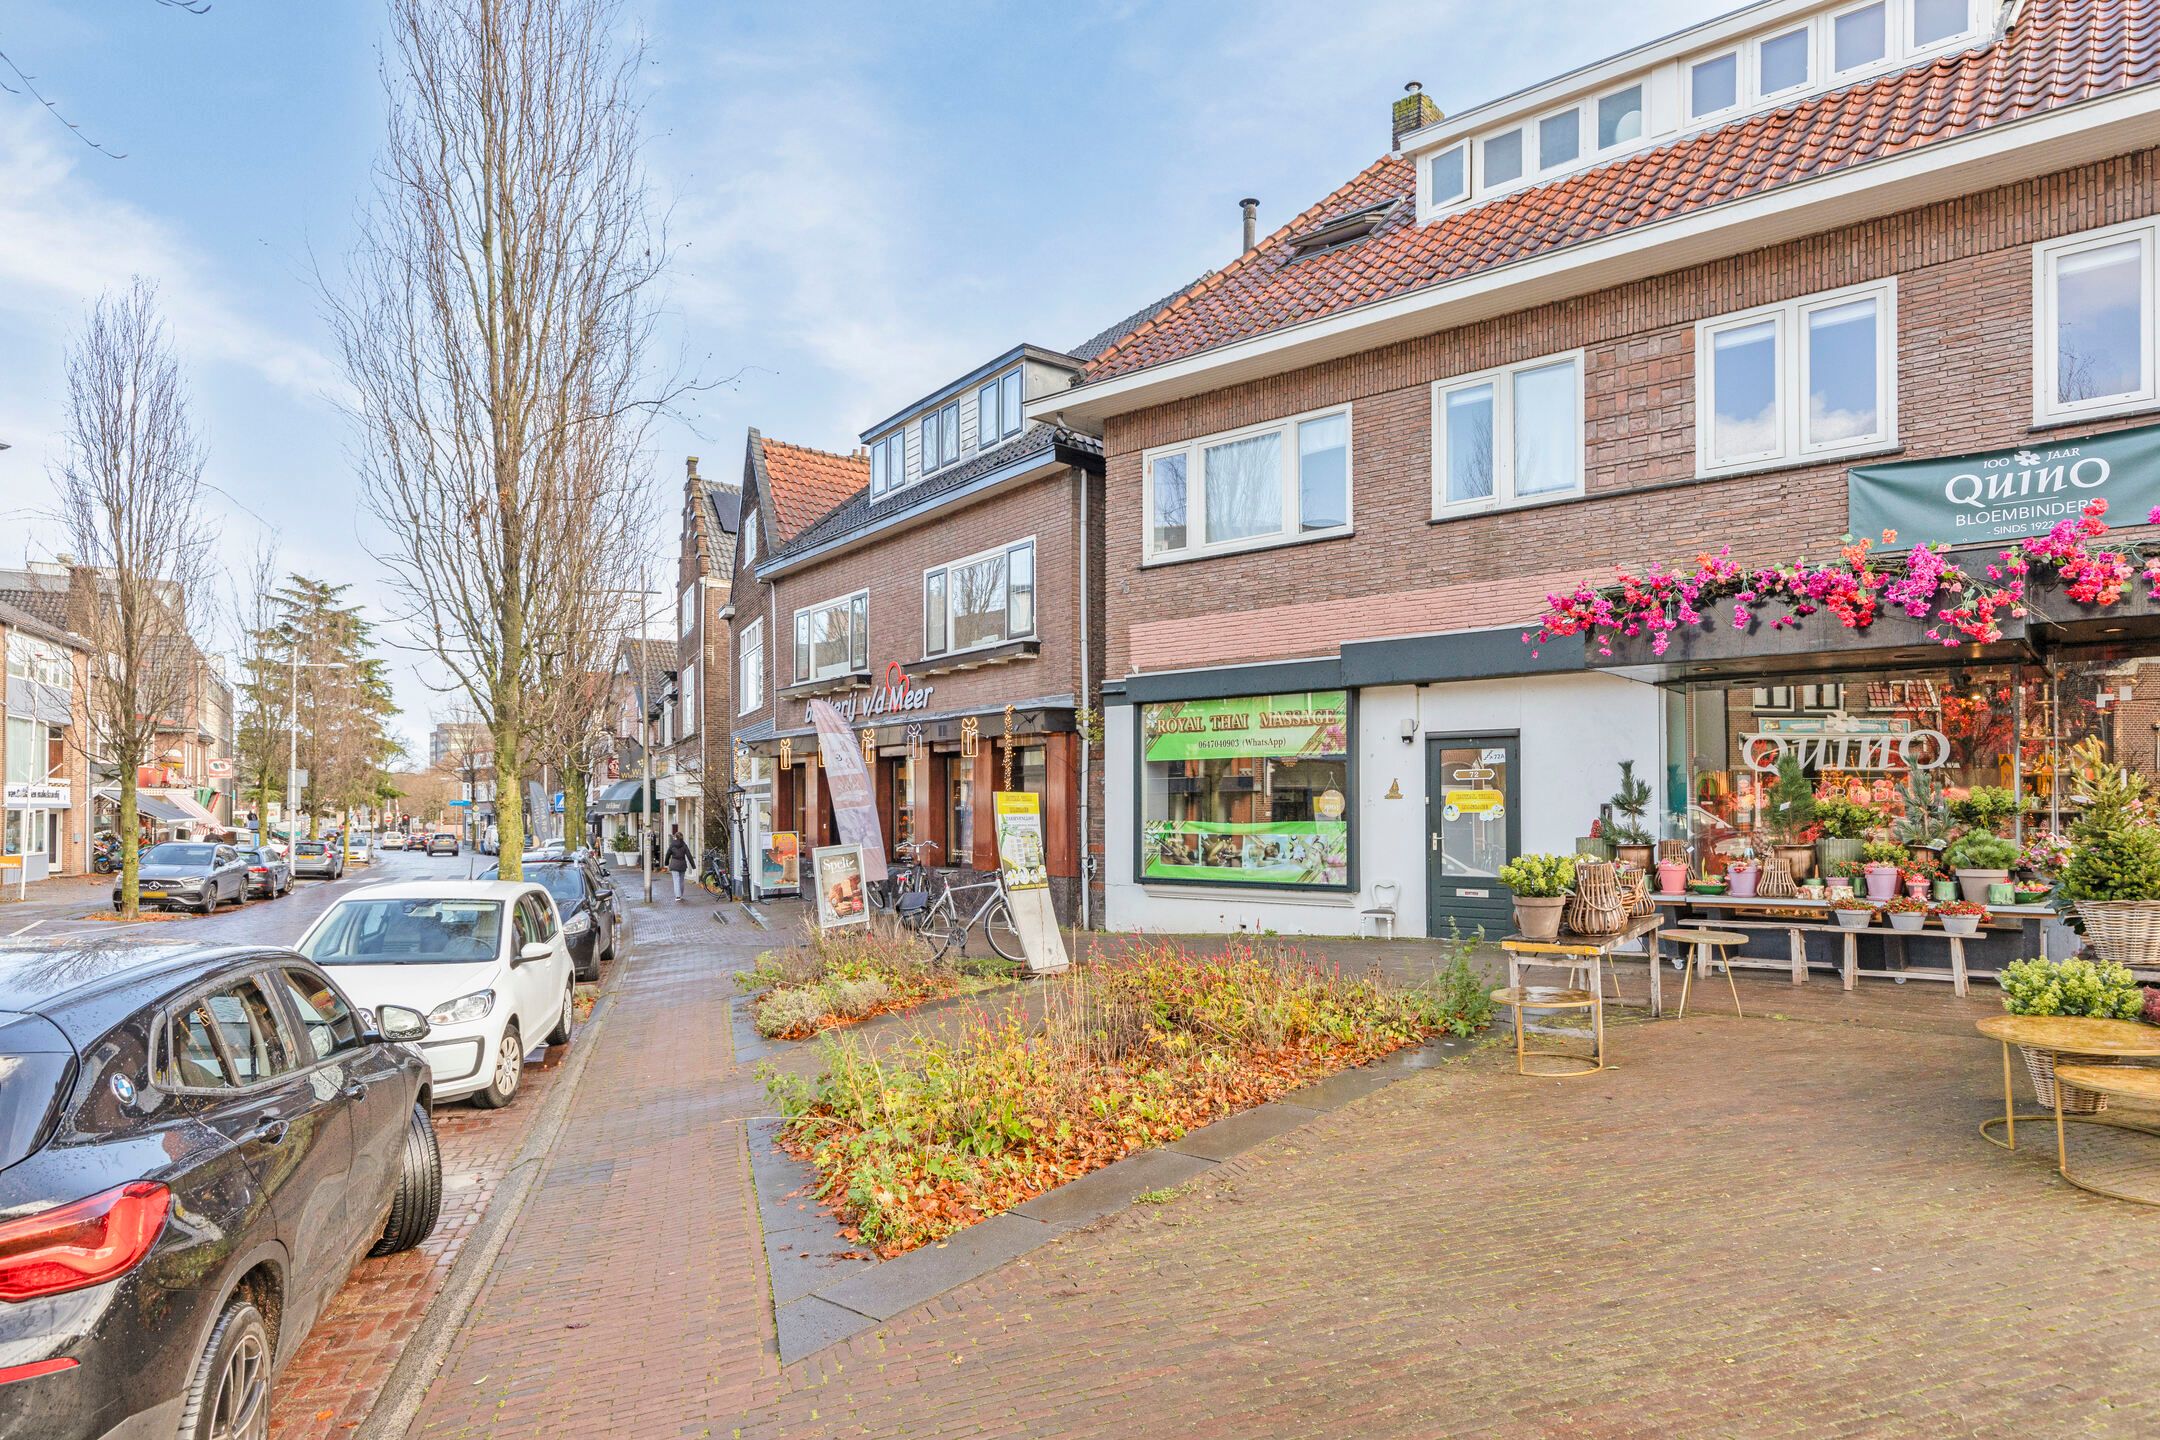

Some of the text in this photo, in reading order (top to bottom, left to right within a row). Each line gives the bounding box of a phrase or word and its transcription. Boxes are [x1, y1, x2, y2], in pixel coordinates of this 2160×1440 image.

[1983, 447, 2081, 469] 100 JAAR
[1993, 520, 2055, 536] SINDS 1922
[804, 685, 934, 723] berij v/d Meer
[1156, 709, 1337, 734] ROYAL THAI MASSAGE
[1242, 737, 1287, 748] (WhatsApp)
[823, 857, 854, 874] Spelt
